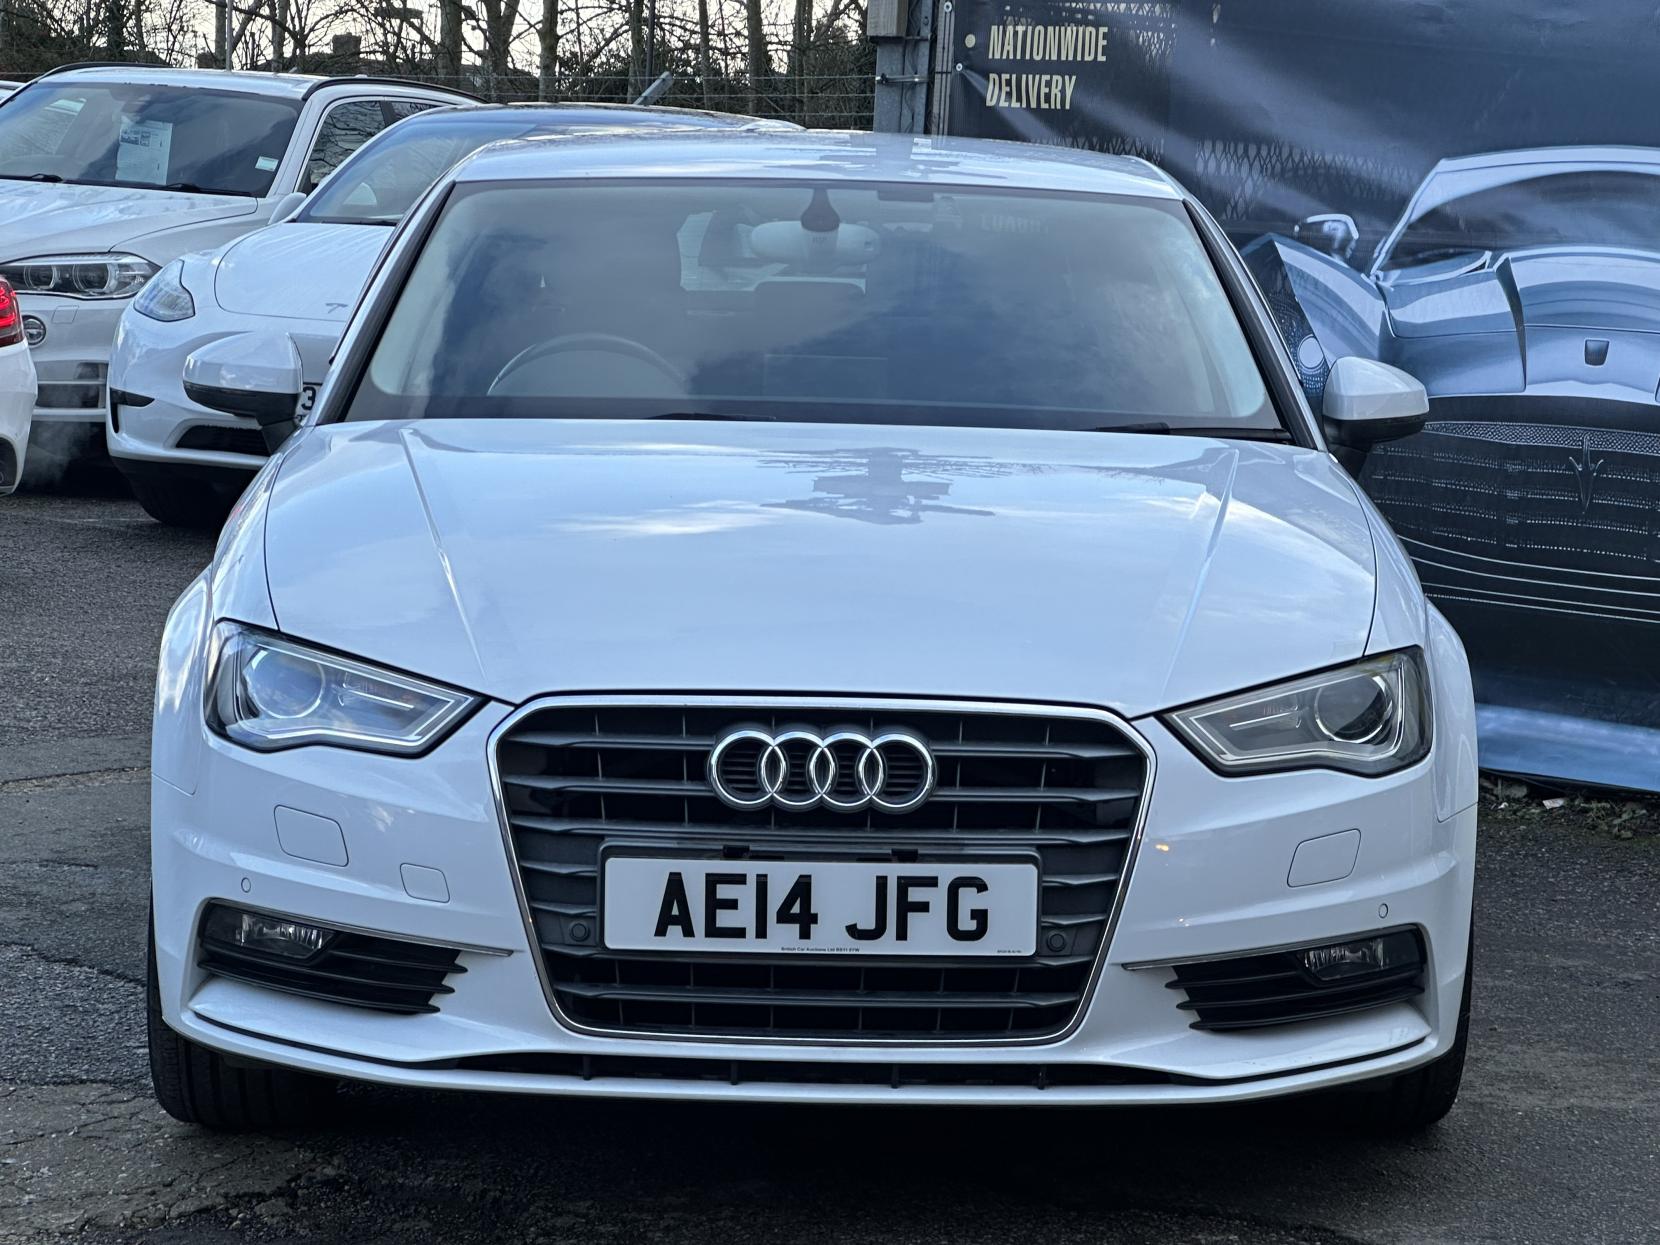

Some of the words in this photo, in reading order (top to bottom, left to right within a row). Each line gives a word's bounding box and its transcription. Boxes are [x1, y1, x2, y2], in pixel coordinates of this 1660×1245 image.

[988, 25, 1108, 62] NATIONWIDE
[985, 73, 1077, 109] DELIVERY
[653, 871, 819, 941] AE14
[845, 874, 989, 942] JFG
